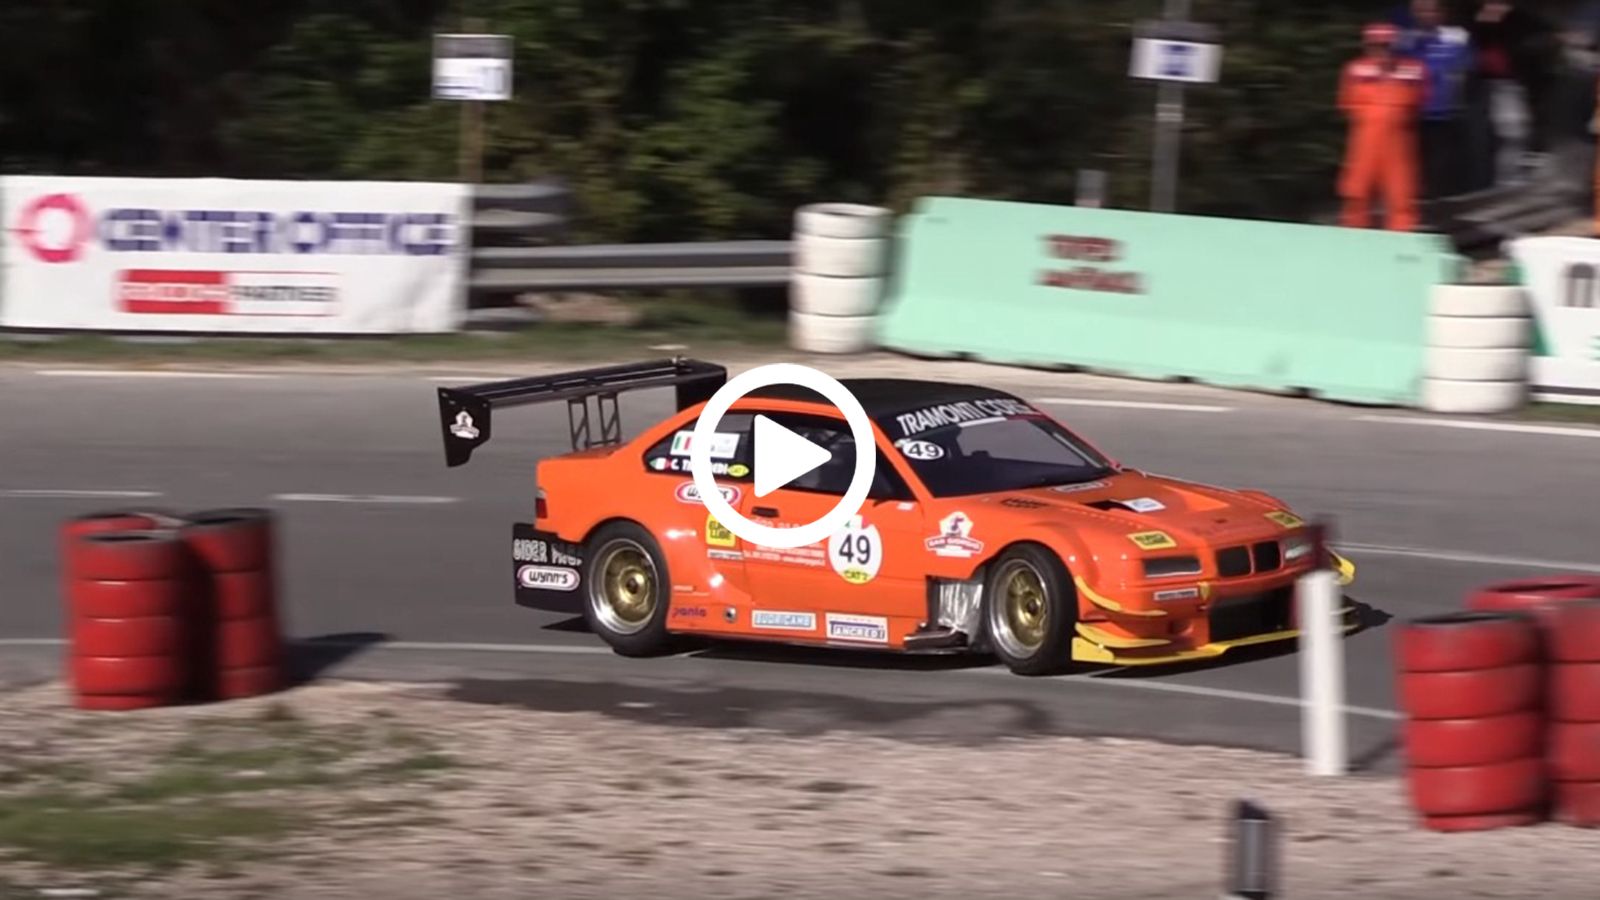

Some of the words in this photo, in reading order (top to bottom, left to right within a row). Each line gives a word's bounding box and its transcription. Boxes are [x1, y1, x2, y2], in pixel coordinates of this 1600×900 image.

[99, 208, 280, 253] CENTER
[896, 401, 988, 437] TRAMONTI
[908, 443, 939, 458] 49
[838, 533, 872, 566] 49
